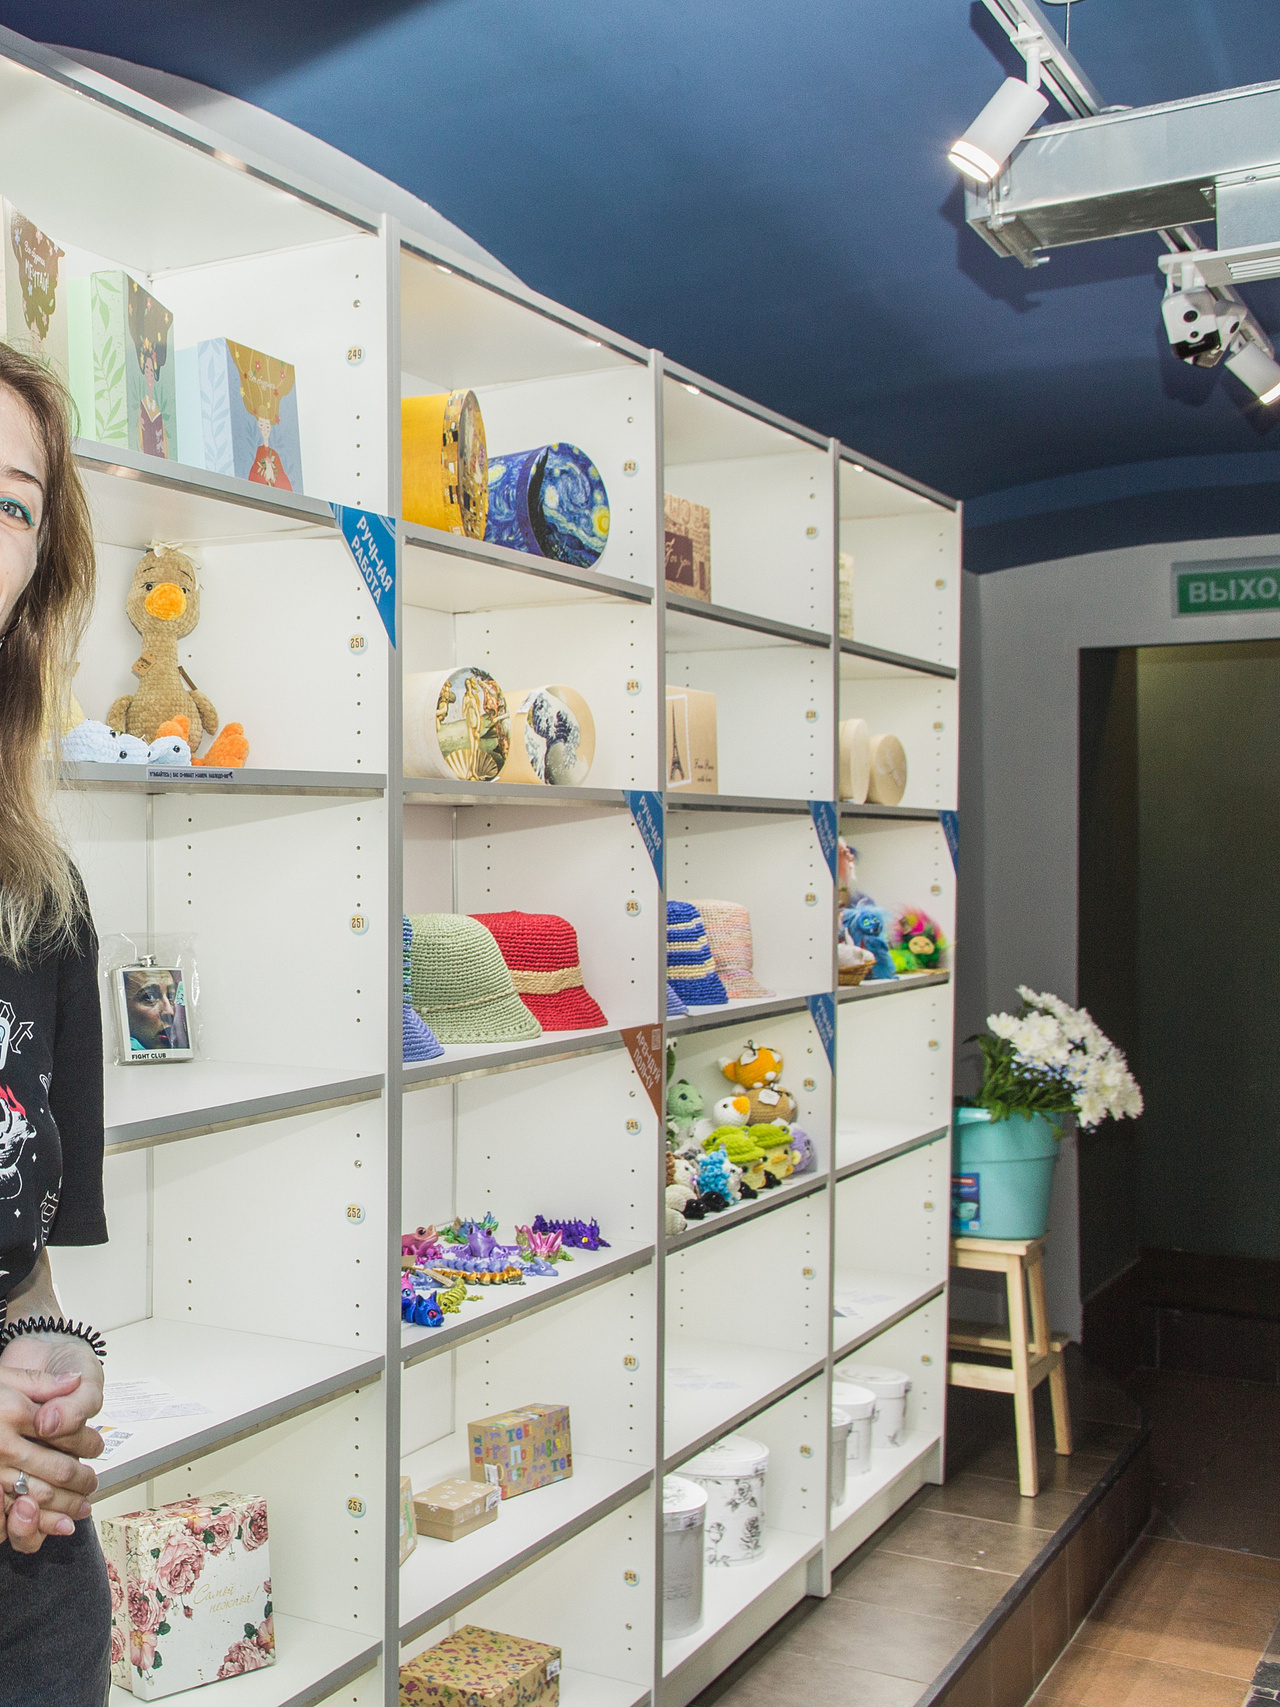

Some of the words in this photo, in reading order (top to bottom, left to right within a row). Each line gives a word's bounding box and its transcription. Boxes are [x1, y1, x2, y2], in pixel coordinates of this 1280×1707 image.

[347, 348, 362, 361] 249
[356, 515, 393, 593] РУЧНАЯ
[351, 535, 382, 605] РАБОТА
[1188, 577, 1280, 604] ВЫХО
[350, 637, 365, 649] 250
[626, 681, 639, 691] 244
[639, 794, 661, 850] РУЧНАЯ
[636, 811, 655, 860] РАБОТА
[626, 902, 638, 912] 245
[351, 917, 364, 929] 251
[633, 1048, 654, 1089] ПОЛКУ
[636, 1031, 662, 1084] АРЕНДУЙ
[347, 1207, 362, 1219] 252
[348, 1499, 362, 1512] 253
[193, 1583, 235, 1604] Самой
[209, 1585, 260, 1613] нежной!
